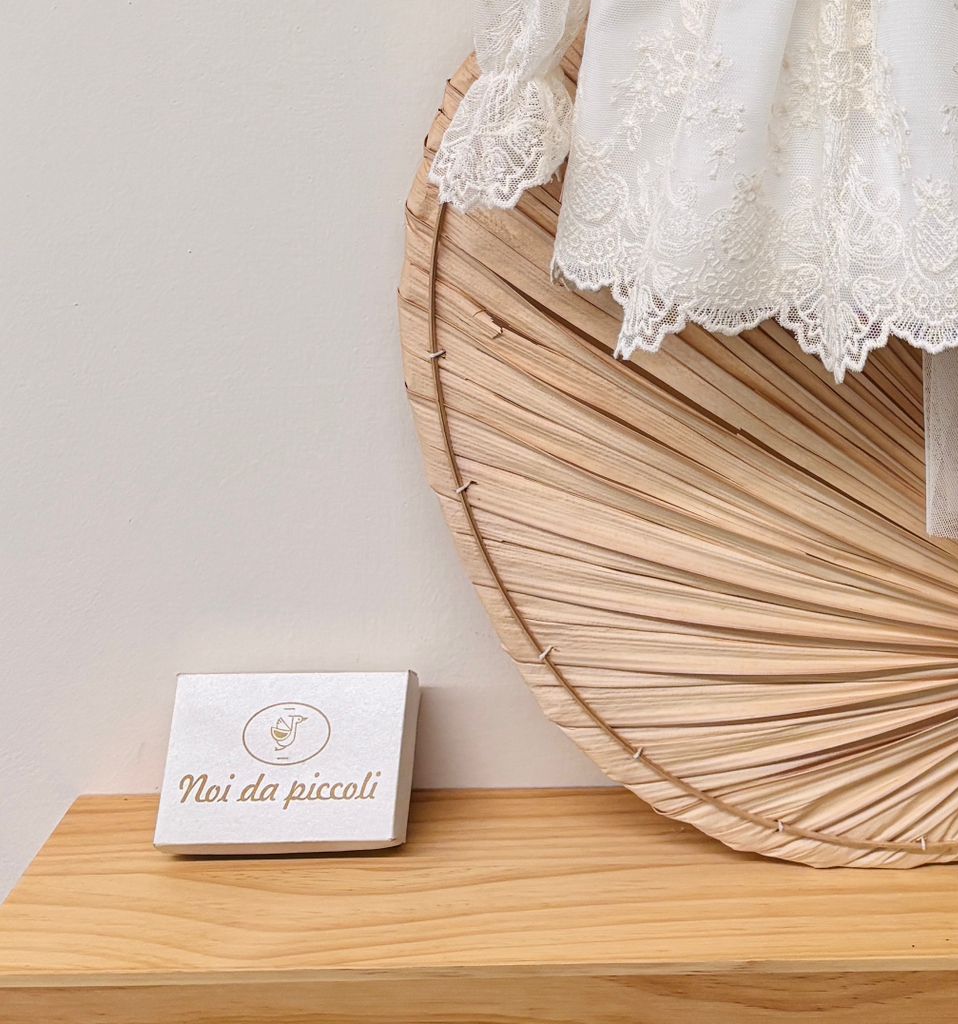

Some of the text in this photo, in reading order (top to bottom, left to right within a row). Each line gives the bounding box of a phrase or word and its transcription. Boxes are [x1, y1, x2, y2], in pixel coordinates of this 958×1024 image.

[178, 770, 382, 810] Noi da piccoli
